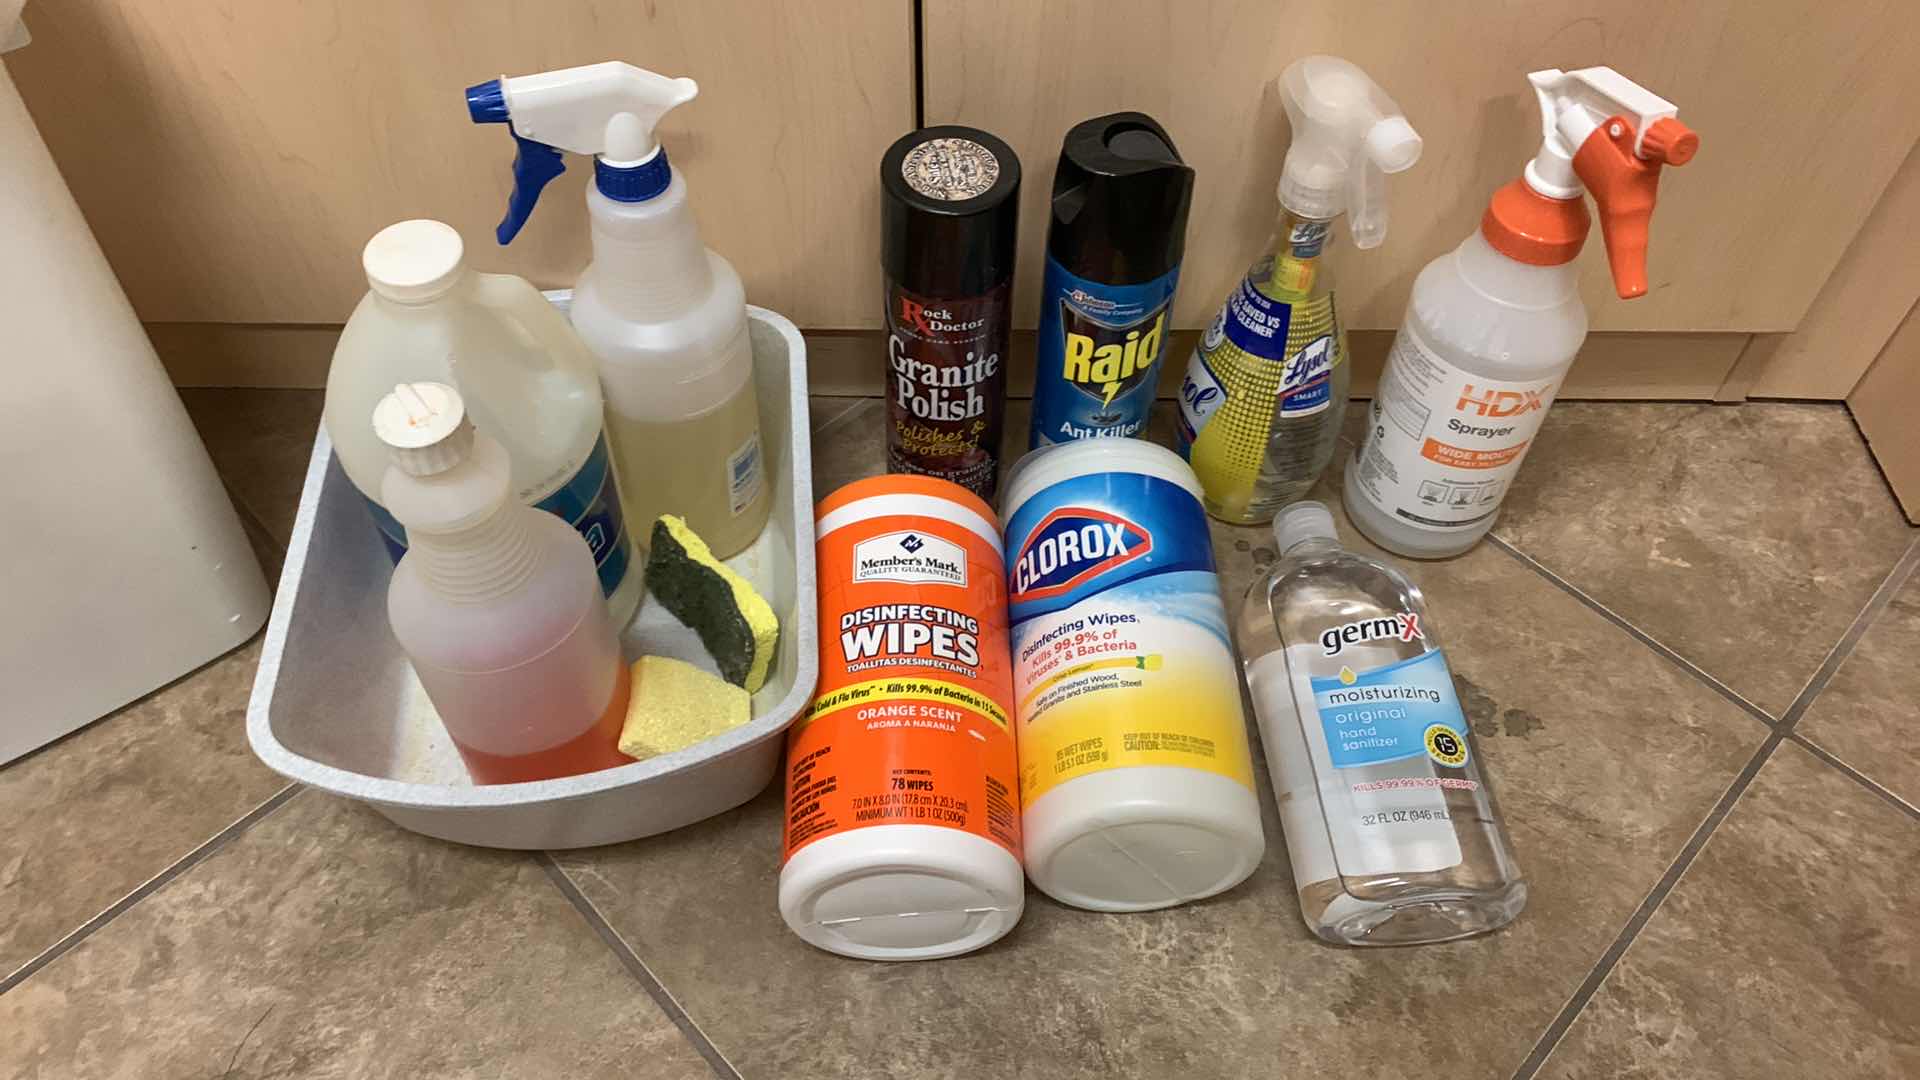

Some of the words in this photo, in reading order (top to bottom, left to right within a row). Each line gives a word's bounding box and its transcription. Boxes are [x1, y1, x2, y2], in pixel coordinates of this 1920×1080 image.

[901, 296, 953, 336] Rock
[930, 318, 985, 332] Doctor
[1268, 315, 1281, 329] VS
[1063, 312, 1165, 383] Raid
[889, 334, 999, 388] Granite
[1285, 338, 1330, 385] Lysol
[896, 373, 985, 421] Polish
[1456, 384, 1553, 417] HDX
[896, 420, 964, 442] Polishes
[971, 420, 985, 435] &
[1060, 421, 1093, 439] Ant
[1097, 419, 1143, 438] Killer
[1447, 418, 1516, 439] Sprayer
[1438, 445, 1472, 460] WIDE
[861, 556, 922, 570] Member's
[1016, 523, 1129, 596] CLOROX
[860, 567, 898, 578] QUALITY
[902, 566, 962, 581] GUARANTEED
[841, 604, 979, 635] DISINFECTING
[841, 622, 980, 668] WIPES
[1022, 619, 1084, 663] Disinfecting
[1032, 646, 1052, 669] Kills
[1054, 630, 1100, 654] 99.9%
[1103, 628, 1119, 640] of
[1065, 649, 1074, 661] &
[1077, 640, 1137, 657] Bacteria
[847, 658, 896, 672] TOALLITAS
[899, 658, 977, 678] DESINFECTANTES
[1058, 678, 1088, 694] Finished
[1090, 672, 1120, 684] Wood,
[1066, 687, 1081, 700] and
[1082, 681, 1119, 693] Stainless
[1120, 680, 1143, 688] Steel
[886, 683, 905, 693] Kills
[907, 683, 933, 694] 99.9%
[934, 686, 943, 695] of
[944, 687, 974, 704] Bacteria
[1329, 686, 1440, 703] moisturizing
[857, 704, 917, 720] ORANGE
[920, 705, 962, 722] SCENT
[1335, 708, 1406, 724] original
[866, 719, 901, 731] AROMA
[904, 719, 911, 729] A
[913, 720, 957, 732] NARANJA
[1339, 726, 1377, 740] hand
[1080, 737, 1104, 753] WIPES
[1342, 737, 1398, 752] sanitizer
[1436, 736, 1456, 752] 15
[892, 778, 905, 791] 78
[907, 779, 934, 792] WIPES
[1352, 780, 1384, 793] KILLS
[864, 796, 871, 807] IN
[872, 795, 879, 806] X
[920, 795, 932, 806] cm
[933, 796, 939, 806] X
[856, 808, 893, 823] MINIMUM
[895, 807, 908, 817] WT
[916, 807, 926, 818] LB
[933, 807, 944, 820] OZ
[1361, 814, 1376, 826] 32
[1378, 811, 1392, 824] FL
[1393, 810, 1408, 823] OZ
[1409, 809, 1432, 823] (946
